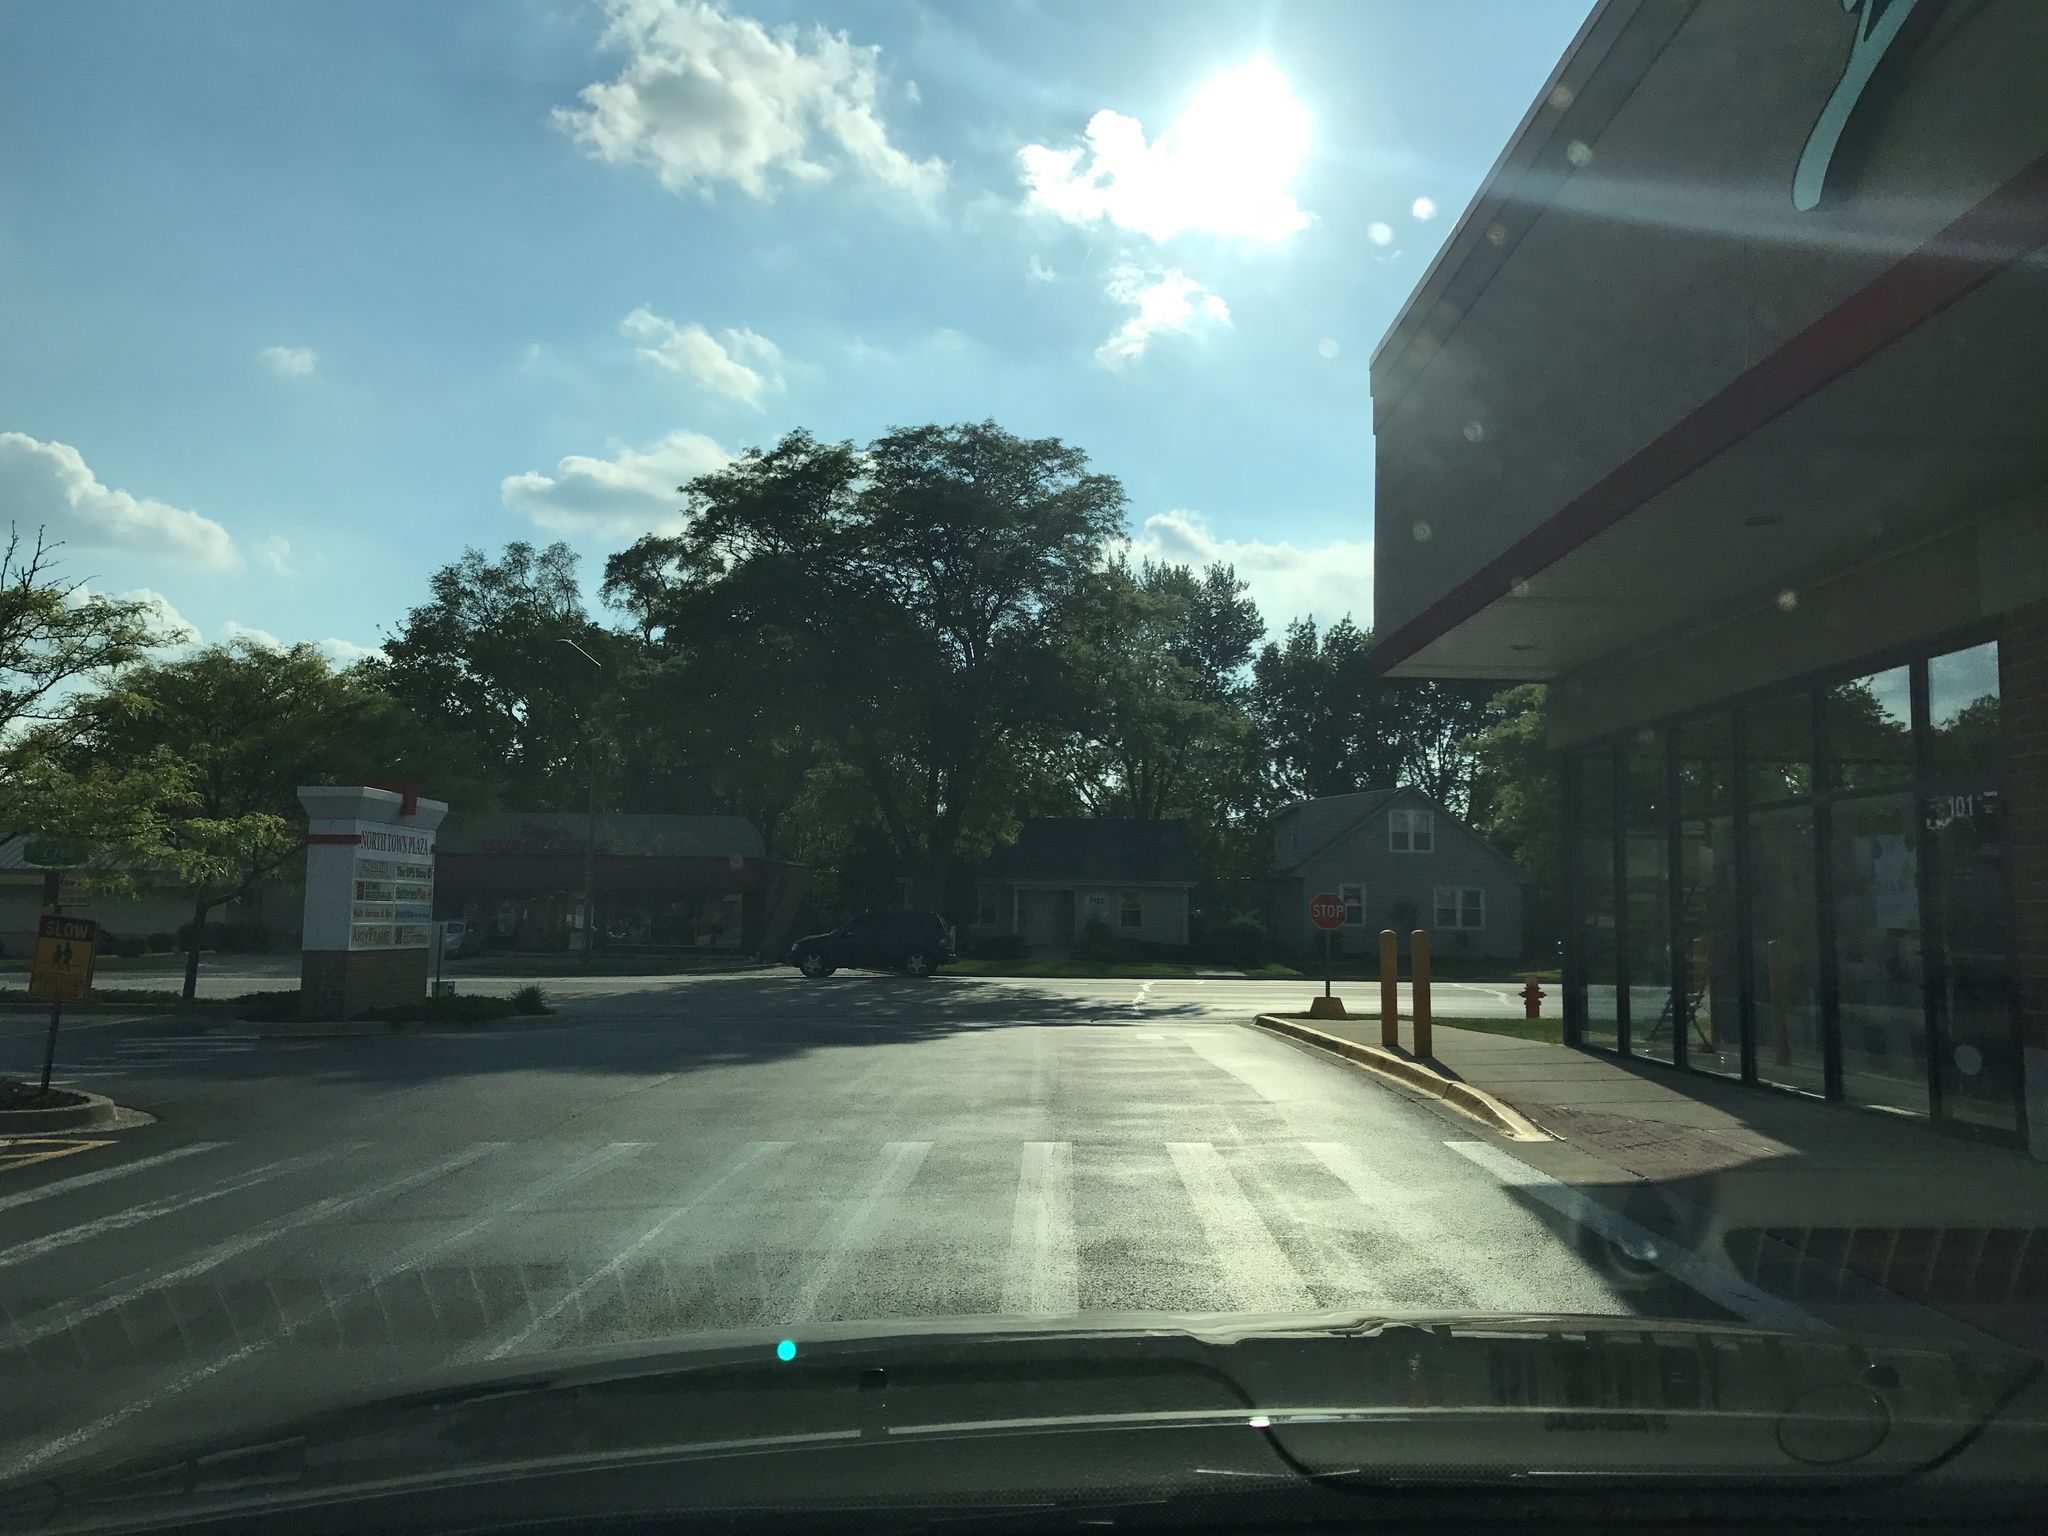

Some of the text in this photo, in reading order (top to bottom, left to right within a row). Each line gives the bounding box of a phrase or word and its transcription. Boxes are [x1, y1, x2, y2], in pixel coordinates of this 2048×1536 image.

[361, 830, 428, 856] NORTH TOWN PLAZA
[405, 867, 415, 878] UPS
[415, 868, 427, 879] Store
[1312, 904, 1344, 918] STOP
[45, 921, 88, 939] SLOW
